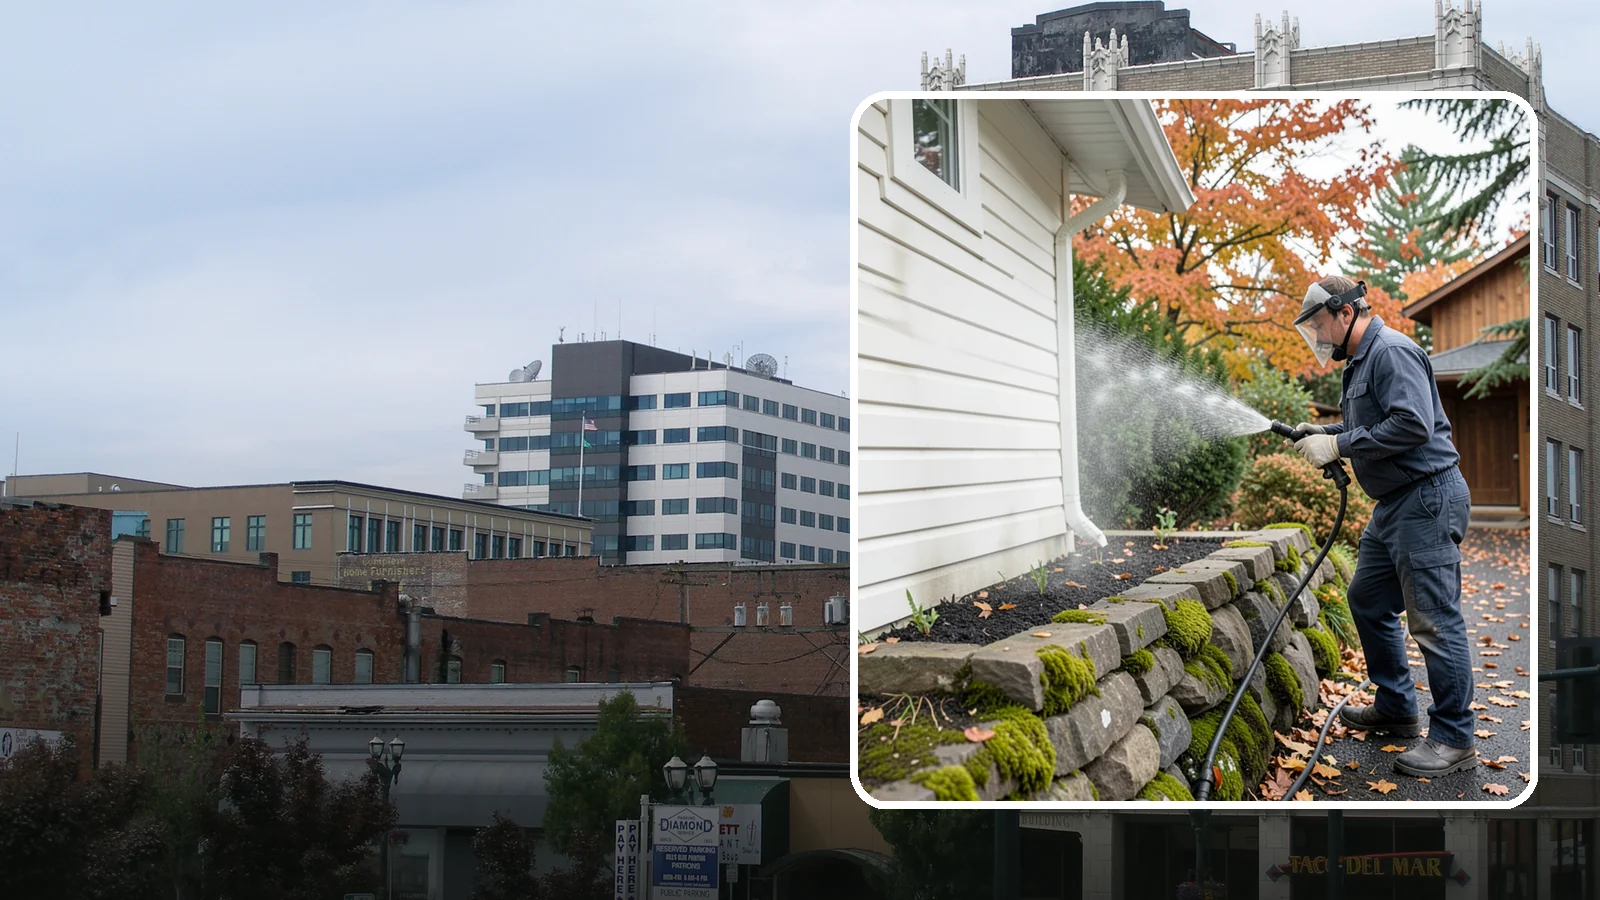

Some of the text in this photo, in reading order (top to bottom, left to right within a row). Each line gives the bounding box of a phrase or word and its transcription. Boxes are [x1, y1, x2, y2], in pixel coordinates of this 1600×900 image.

[370, 566, 427, 577] Furnishers
[660, 818, 713, 833] DIAMOND
[1021, 815, 1070, 828] BUILDING
[719, 824, 740, 835] ETT
[719, 840, 740, 849] ANT
[617, 825, 625, 893] PAY HERE
[722, 851, 739, 861] Soup
[671, 862, 701, 870] PATRONS
[1346, 855, 1384, 876] DEL
[1392, 856, 1442, 877] MAR
[628, 856, 636, 893] HERE
[660, 888, 710, 898] PUBLIC PARKING
